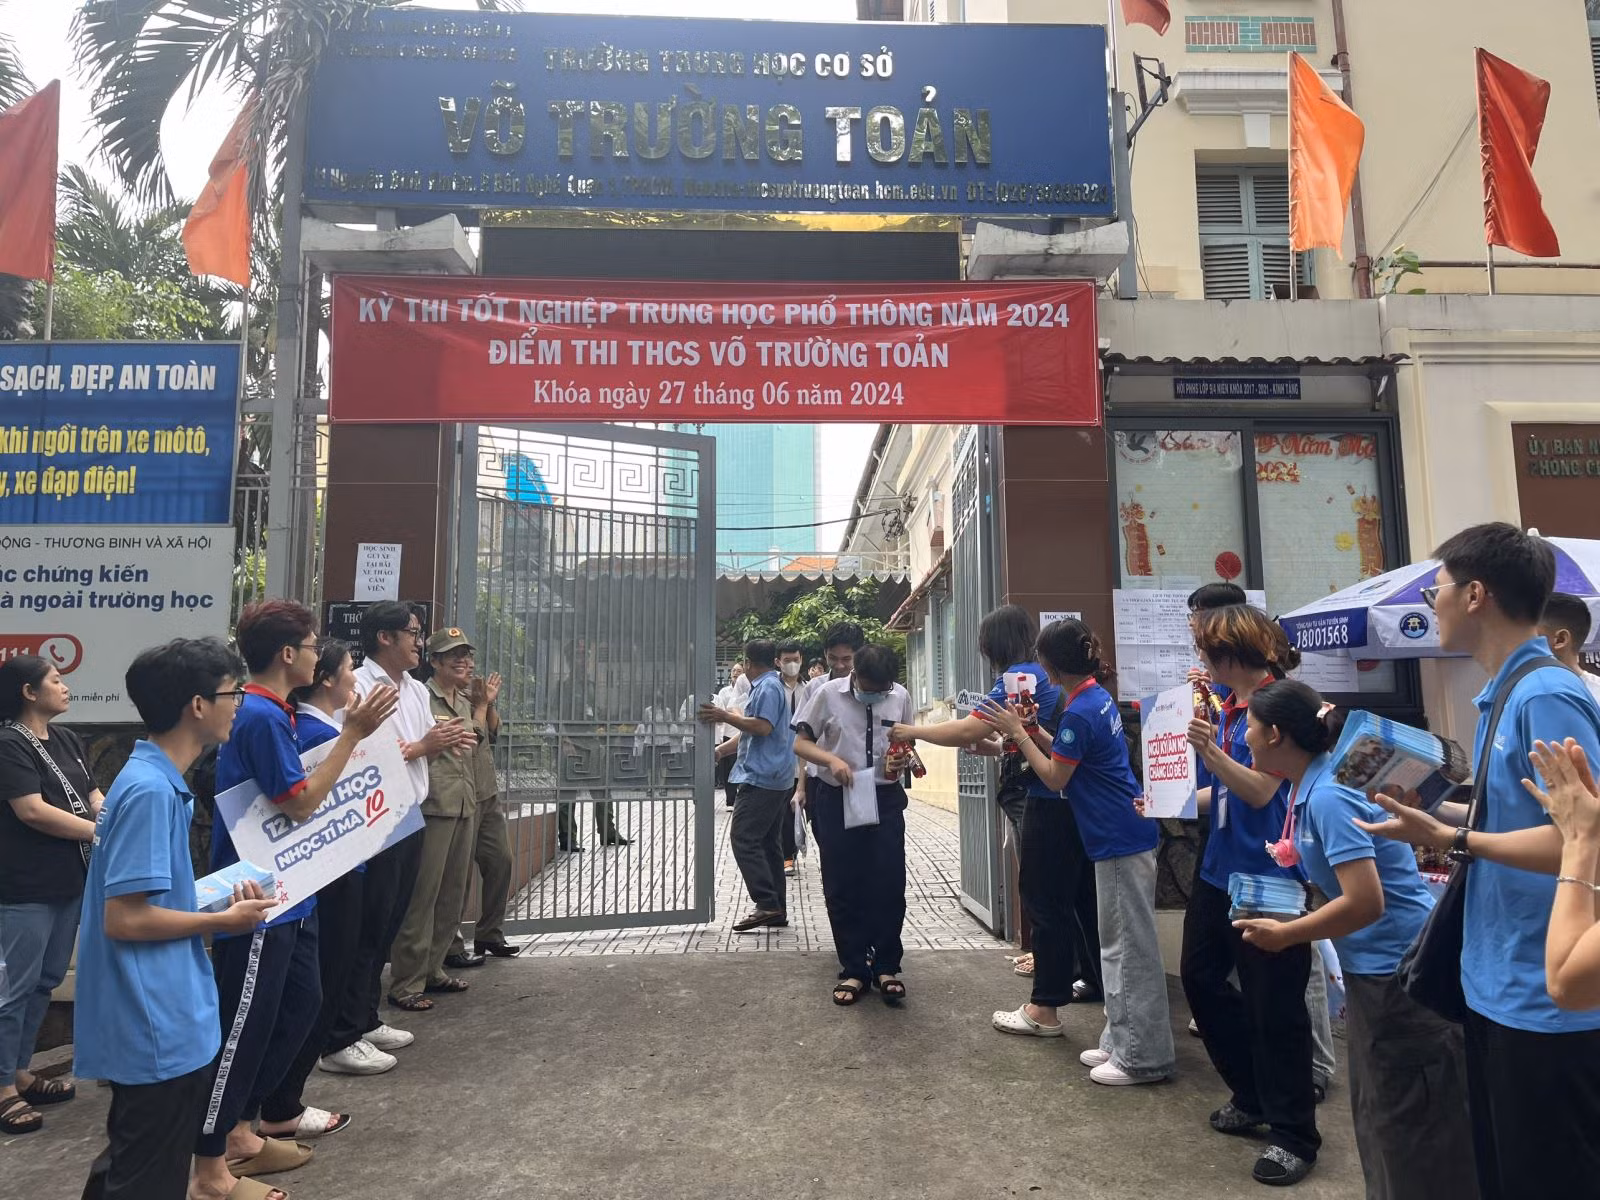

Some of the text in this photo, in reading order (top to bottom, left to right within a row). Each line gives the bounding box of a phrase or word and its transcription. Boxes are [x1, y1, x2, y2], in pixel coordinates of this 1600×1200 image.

[543, 41, 649, 72] TRƯỜNG
[658, 48, 745, 75] TRUNG
[754, 52, 806, 80] HỌC
[814, 51, 850, 77] CƠ
[860, 45, 893, 78] SỞ
[438, 79, 992, 164] VÕ TRƯỜNG TOẢN
[359, 291, 1070, 330] KỲ THI TỐT NGHIỆP TRUNG HỌC PHỔ THÔNG NĂM 2024
[488, 326, 949, 368] ĐIỂM THI THCS VÕ TRƯỜNG TOẢN
[0, 360, 216, 397] SẠCH, ĐẸP, AN TOÀN
[533, 379, 905, 410] Khóa ngày 27 tháng 06 năm 2024
[32, 423, 77, 457] ngồi
[80, 425, 123, 454] trên
[125, 429, 150, 454] xe
[153, 425, 210, 456] môtô,
[1553, 438, 1584, 455] BAN
[14, 470, 37, 494] xe
[41, 466, 80, 501] đạp
[83, 465, 137, 501] điện!
[0, 536, 31, 550] ỘNG
[44, 536, 105, 549] THƯƠNG
[109, 537, 142, 549] BINH
[145, 536, 162, 549] VÀ
[166, 535, 184, 549] XÃ
[187, 536, 212, 550] HỘI
[22, 565, 93, 585] chứng
[99, 563, 148, 583] kiến
[19, 590, 83, 613] ngoài
[89, 591, 165, 612] trường
[170, 590, 213, 612] học
[1296, 624, 1349, 648] 18001568
[72, 800, 85, 815] LB
[265, 768, 379, 840] 12 HỌC
[277, 836, 322, 870] NHỌC
[321, 822, 338, 842] TÍ
[338, 811, 364, 835] MÀ
[365, 789, 385, 819] 10
[231, 1001, 250, 1041] EDUCATION
[219, 1065, 229, 1082] SEN
[206, 1081, 224, 1127] UNIVERSITY
